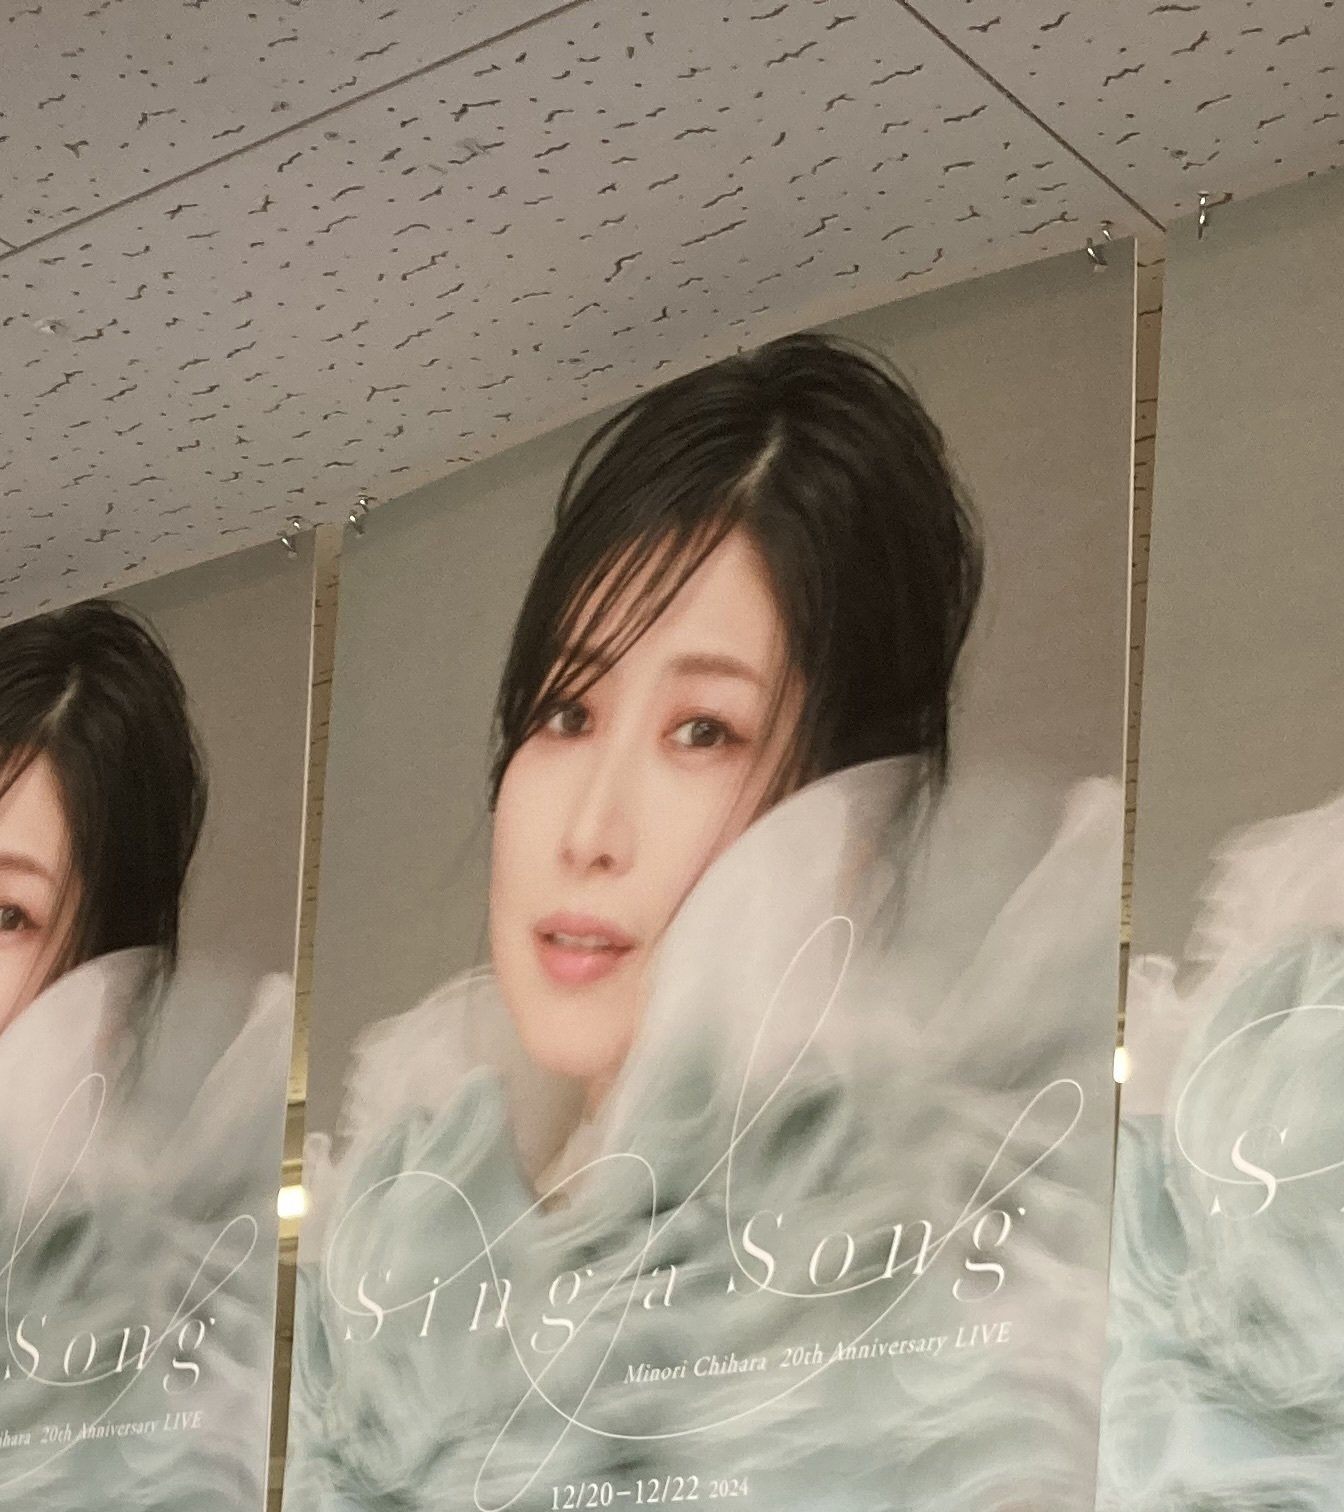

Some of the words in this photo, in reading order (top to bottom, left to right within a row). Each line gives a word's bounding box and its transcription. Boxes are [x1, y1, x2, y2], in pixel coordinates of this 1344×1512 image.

[344, 1266, 593, 1352] Sing
[727, 1206, 1026, 1301] Song
[4, 1313, 216, 1395] Song
[624, 1351, 686, 1385] Minori
[693, 1344, 766, 1379] Chihara
[780, 1338, 823, 1368] 20th
[829, 1327, 947, 1362] Anniversary
[955, 1321, 1011, 1348] LIVE
[40, 1424, 72, 1445] 20th
[75, 1417, 157, 1443] Anniversary
[162, 1410, 204, 1432] LIVE
[709, 1477, 749, 1499] 2024
